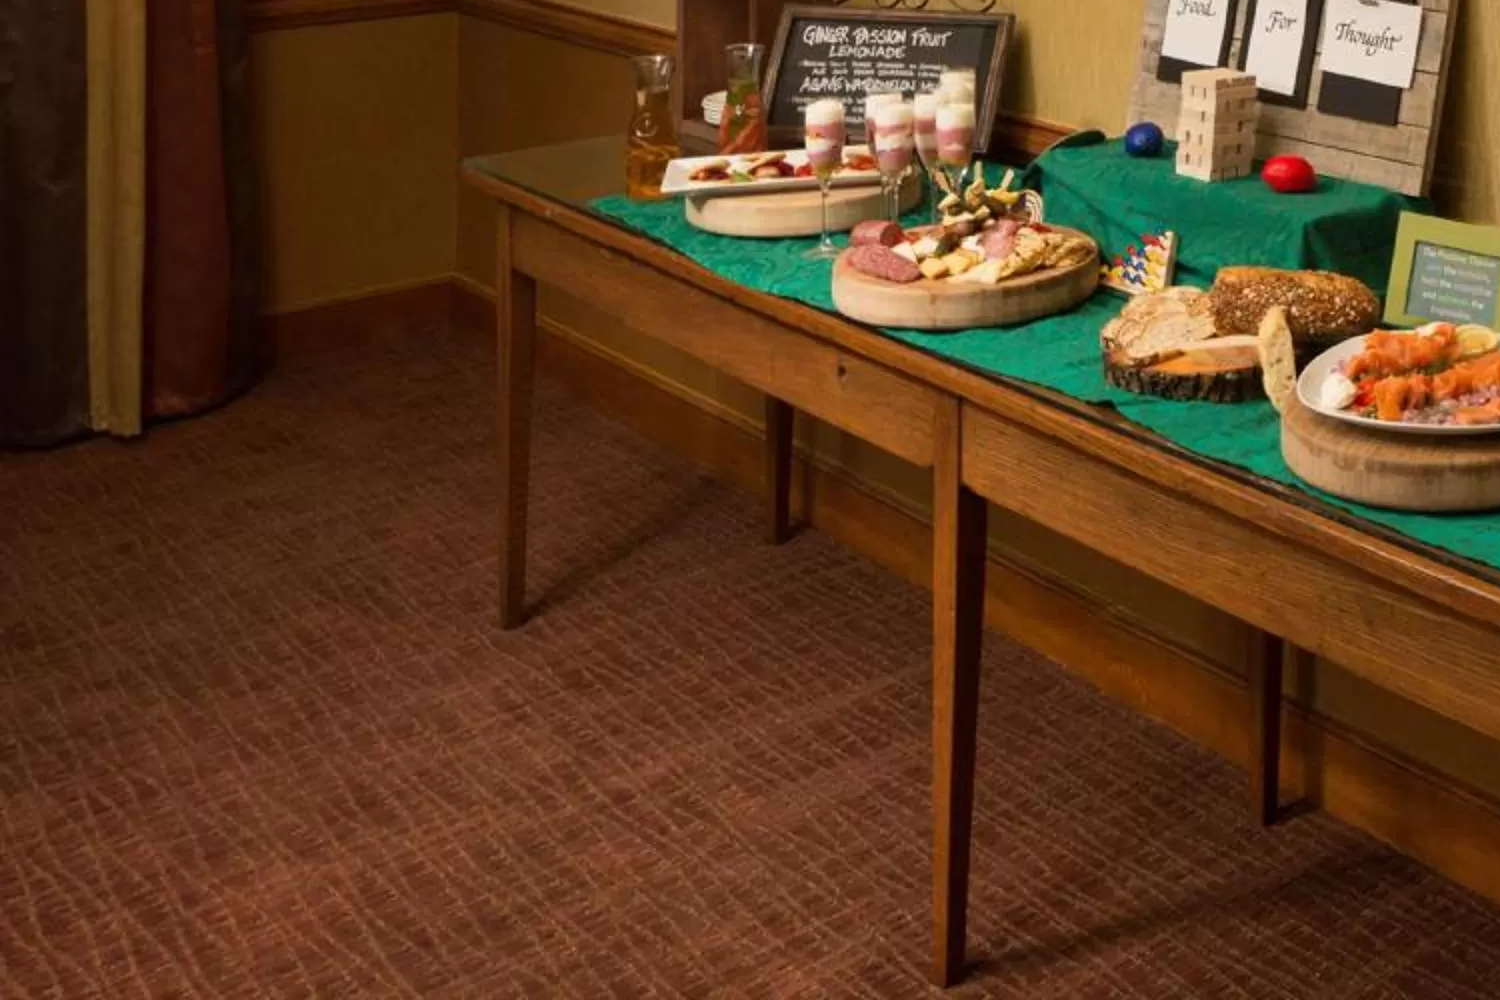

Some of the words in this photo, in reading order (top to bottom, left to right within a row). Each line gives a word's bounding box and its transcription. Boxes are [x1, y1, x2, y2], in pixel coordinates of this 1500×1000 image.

[803, 24, 849, 46] GINGER
[911, 26, 953, 47] FRUIT
[1265, 10, 1297, 33] For
[1335, 19, 1402, 57] Thought
[828, 45, 906, 59] LEMONADE
